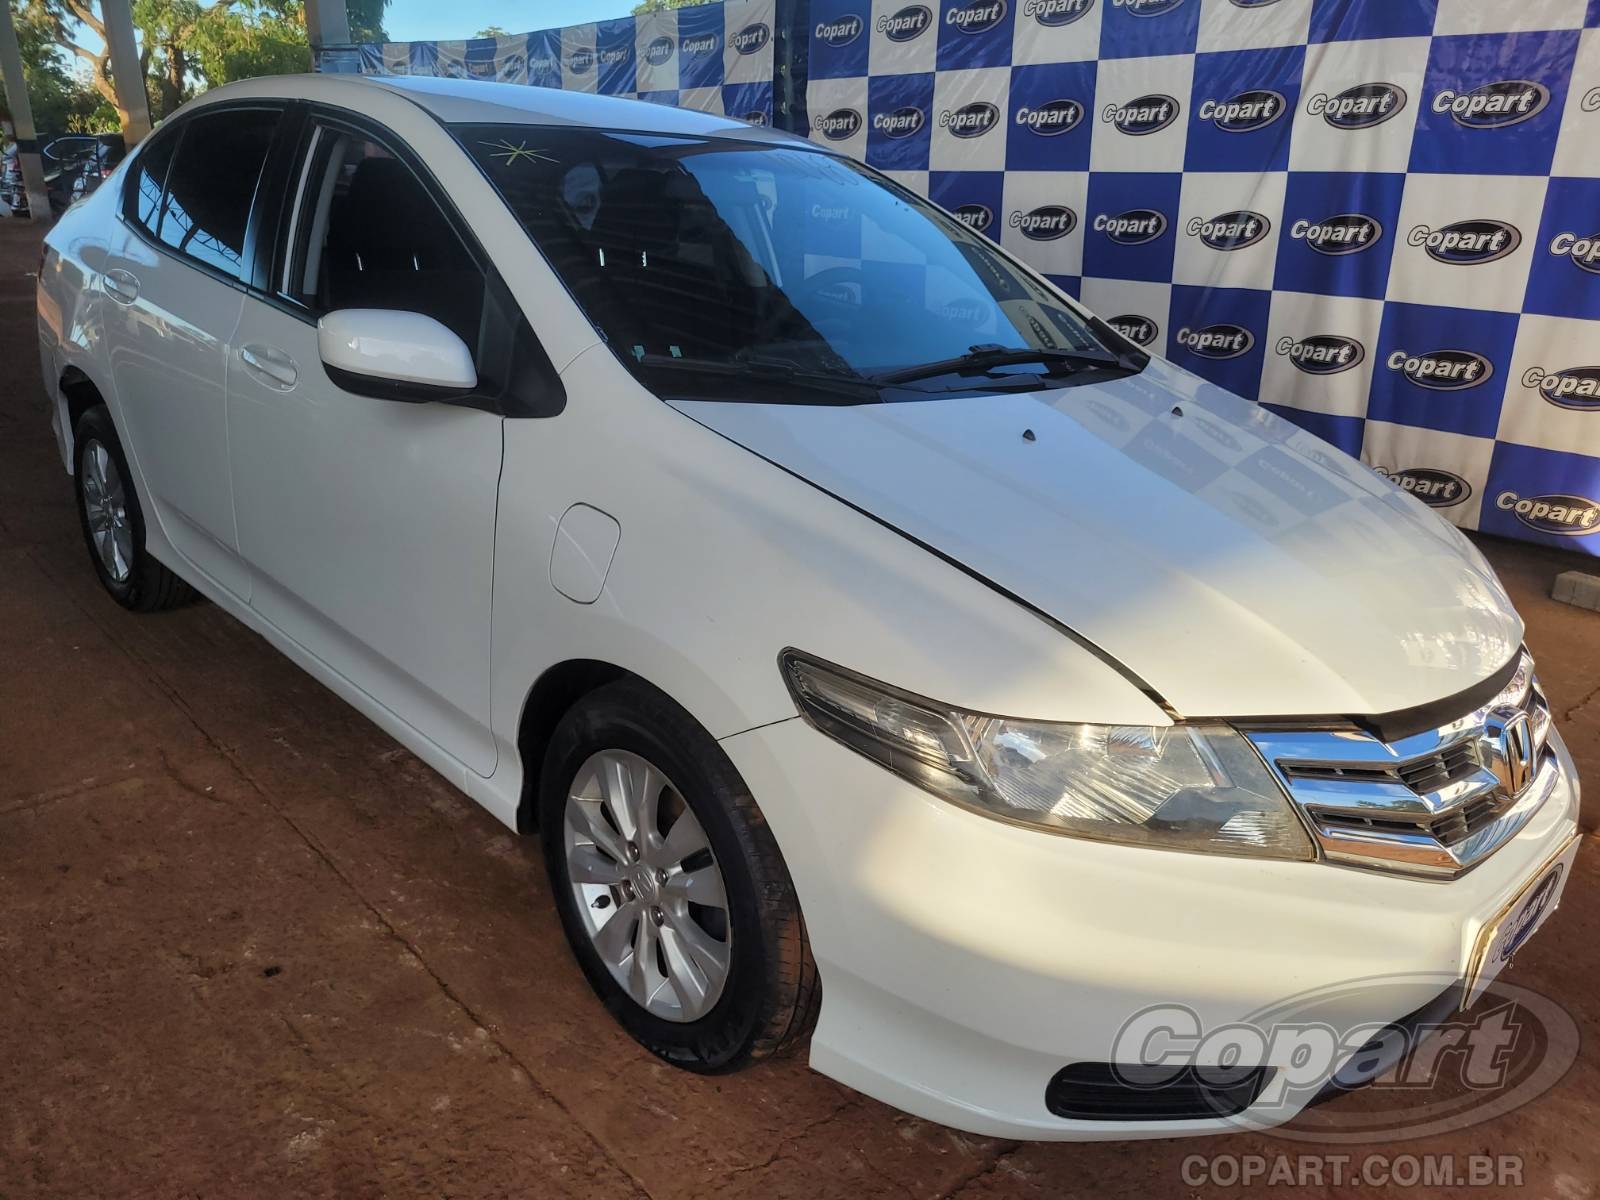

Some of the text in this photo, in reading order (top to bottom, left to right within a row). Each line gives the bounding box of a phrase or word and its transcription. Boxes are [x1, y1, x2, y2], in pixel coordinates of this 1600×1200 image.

[876, 11, 924, 34] Copart
[946, 2, 1000, 28] Copart
[815, 20, 858, 41] Copart
[682, 34, 715, 54] Copart
[1102, 102, 1170, 126] Copart
[1199, 95, 1276, 123] Copart
[1307, 88, 1396, 116] Copart
[1432, 87, 1538, 121] Copart
[814, 114, 855, 131] Copart
[873, 112, 919, 130] Copart
[939, 109, 992, 131] Copart
[1016, 105, 1076, 128] Copart
[1009, 209, 1067, 231] Copart
[1093, 213, 1158, 237] Copart
[1186, 216, 1258, 240] Copart
[1290, 218, 1372, 244] Copart
[1407, 225, 1506, 254] Copart
[1549, 232, 1600, 264] Cop
[1177, 328, 1244, 351] Copart
[1275, 336, 1354, 364] Copart
[1387, 351, 1482, 382] Copart
[1521, 366, 1600, 399] Copa
[1496, 490, 1600, 528] Copart
